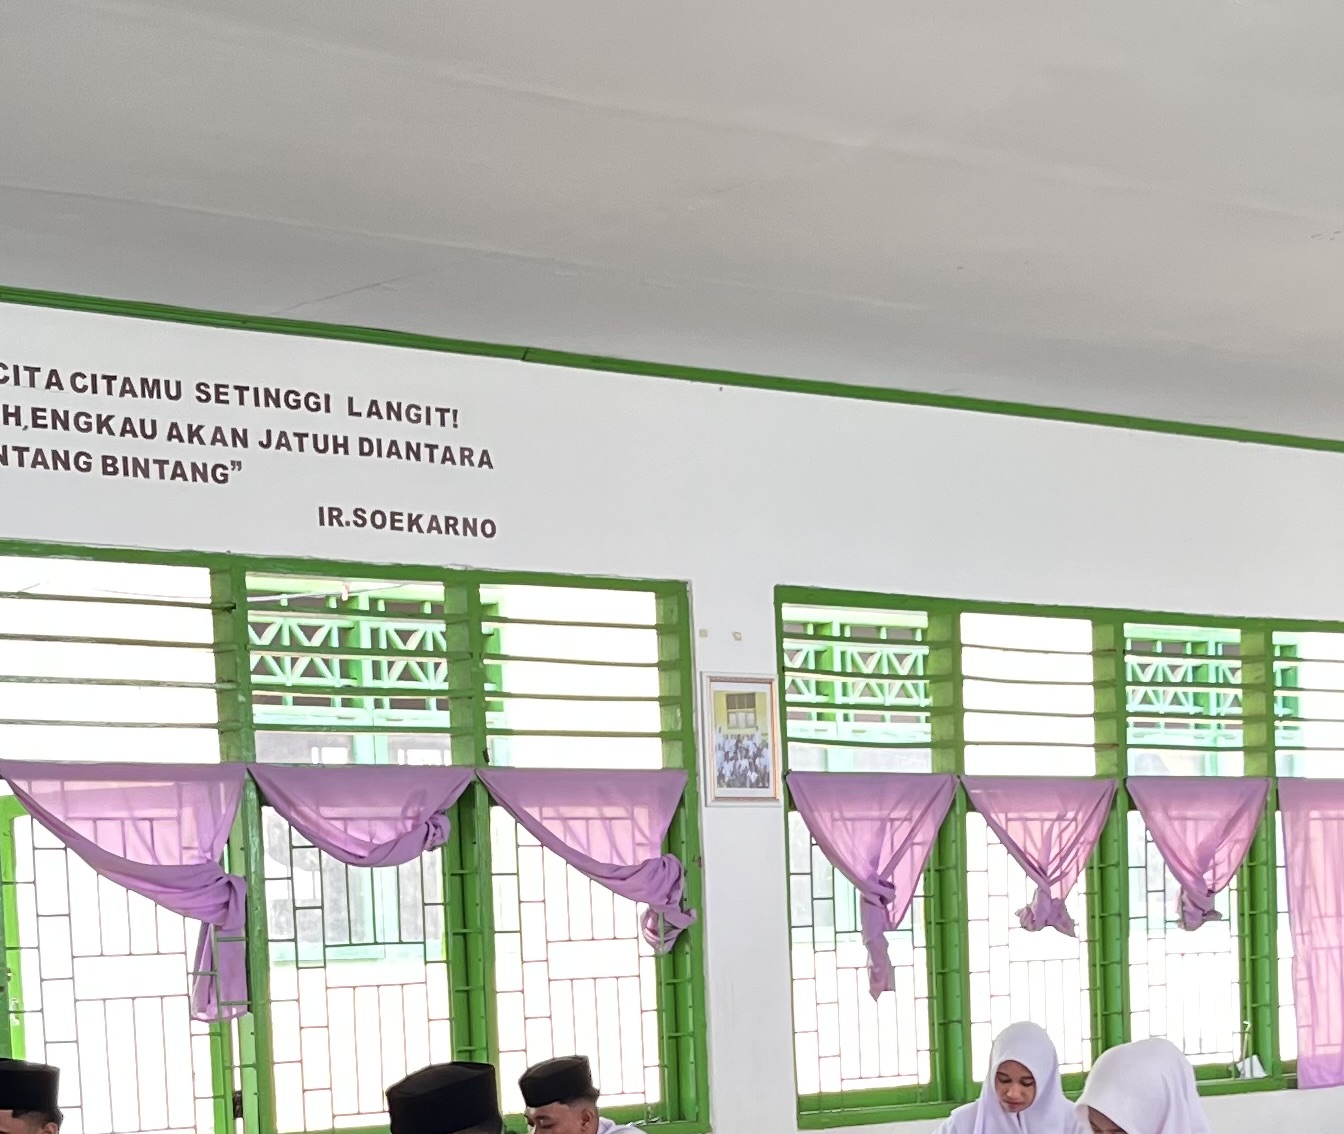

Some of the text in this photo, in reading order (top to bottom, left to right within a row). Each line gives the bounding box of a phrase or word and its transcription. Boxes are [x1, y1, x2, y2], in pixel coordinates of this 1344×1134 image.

[195, 381, 331, 414] SETINGGI
[347, 396, 459, 429] LANGIT!
[166, 421, 249, 449] AKAN
[258, 428, 350, 456] JATUH
[358, 436, 494, 470] DIANTARA
